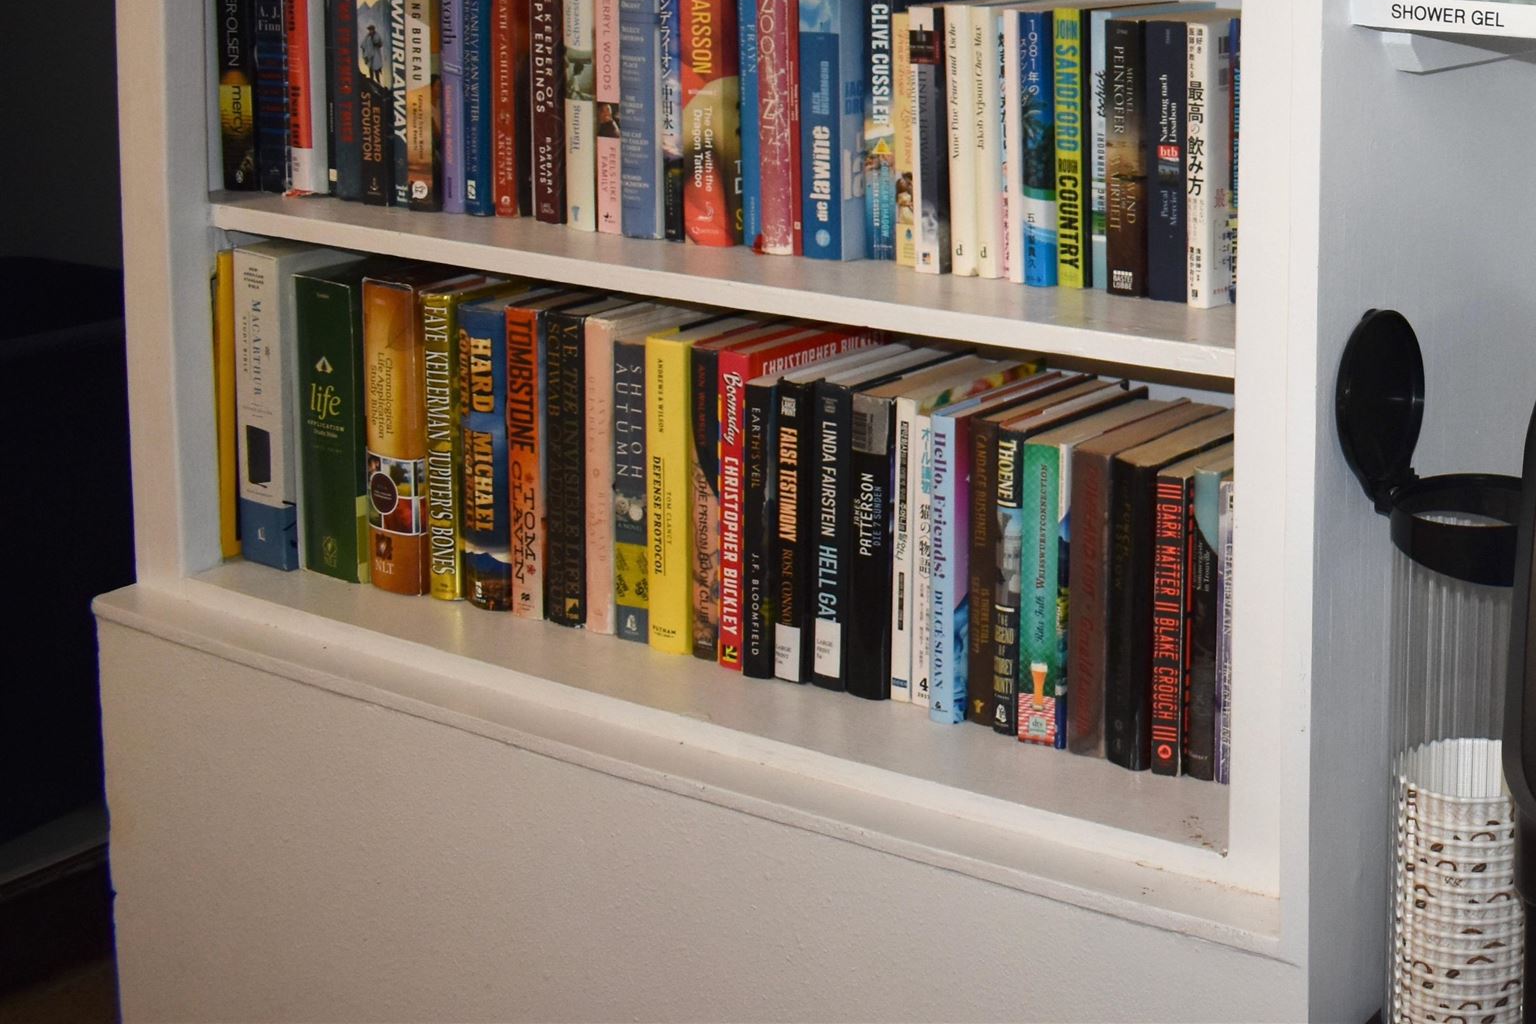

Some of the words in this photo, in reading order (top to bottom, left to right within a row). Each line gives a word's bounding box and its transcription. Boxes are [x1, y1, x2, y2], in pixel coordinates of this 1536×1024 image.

[871, 4, 889, 55] CLIVE
[1391, 3, 1466, 24] SHOWER
[1471, 10, 1505, 27] GEL
[412, 27, 423, 82] BUREAU
[544, 14, 554, 76] KEEPER
[602, 41, 613, 91] WOODS
[949, 55, 957, 75] und
[534, 33, 546, 114] ENDINGS
[545, 86, 554, 109] OF
[872, 56, 890, 125] CUSSLER
[1056, 44, 1079, 152] SANDFORD
[1113, 45, 1126, 135] PEINKOFER
[1158, 74, 1168, 96] nach
[231, 85, 243, 134] mercy
[360, 91, 373, 162] STOURTON
[371, 105, 383, 163] EDWARD
[693, 110, 704, 152] Dragon
[704, 106, 713, 124] The
[951, 109, 959, 131] Fine
[1159, 99, 1169, 143] Nachtzug
[1168, 102, 1178, 143] Lissabon
[608, 146, 616, 177] FEELS
[704, 126, 713, 148] Girl
[705, 151, 713, 173] with
[810, 125, 831, 200] lawine
[952, 134, 960, 160] Anne
[1160, 147, 1180, 158] btb
[538, 146, 547, 184] DAVIS
[545, 136, 554, 195] BARBARA
[600, 154, 609, 193] FAMILY
[695, 153, 704, 189] Tattoo
[705, 174, 713, 192] the
[609, 179, 617, 203] LIKE
[816, 201, 829, 223] die
[1058, 177, 1081, 270] COUNTRY
[424, 305, 448, 342] FAYE
[369, 364, 378, 395] Study
[377, 352, 385, 373] Life
[470, 337, 494, 413] HARD
[508, 319, 535, 454] TOMBSTONE
[310, 383, 341, 420] life
[371, 397, 379, 426] Bible
[377, 375, 386, 439] Application
[384, 358, 395, 436] Chronological
[425, 351, 451, 441] KELLERMAN
[615, 363, 628, 476] AUTUMN
[630, 364, 642, 478] SHILOH
[723, 371, 743, 446] Boomsday
[751, 407, 761, 460] EARTHS
[779, 427, 798, 465] FALSE
[821, 420, 838, 462] LINDA
[428, 449, 453, 522] JUPITER'S
[473, 431, 494, 531] MICHAEL
[652, 456, 663, 509] DEFENSE
[751, 463, 761, 489] VEIL
[933, 432, 948, 493] Hello,
[998, 440, 1018, 501] THOENE
[511, 460, 525, 584] CLAVIN
[523, 489, 536, 561] TOM
[723, 456, 739, 565] CHRISTOPHER
[779, 469, 798, 543] TESTIMONY
[820, 467, 838, 537] FAIRSTEIN
[859, 472, 874, 557] PATTERSON
[1035, 463, 1048, 590] WEISSWURSTCONNECTION
[1158, 504, 1182, 538] DARK
[431, 526, 456, 576] BONES
[652, 513, 663, 575] PROTOCOL
[933, 495, 948, 580] Friends!
[375, 560, 395, 575] NLT
[818, 545, 838, 586] HELL
[1157, 544, 1181, 596] MATTER
[723, 567, 738, 635] BUCKLEY
[751, 579, 761, 656] BLOOMFIELD
[1155, 616, 1180, 660] BLAKE
[919, 677, 930, 692] 4
[934, 640, 944, 690] SLOAN
[1153, 665, 1179, 720] CROUCH
